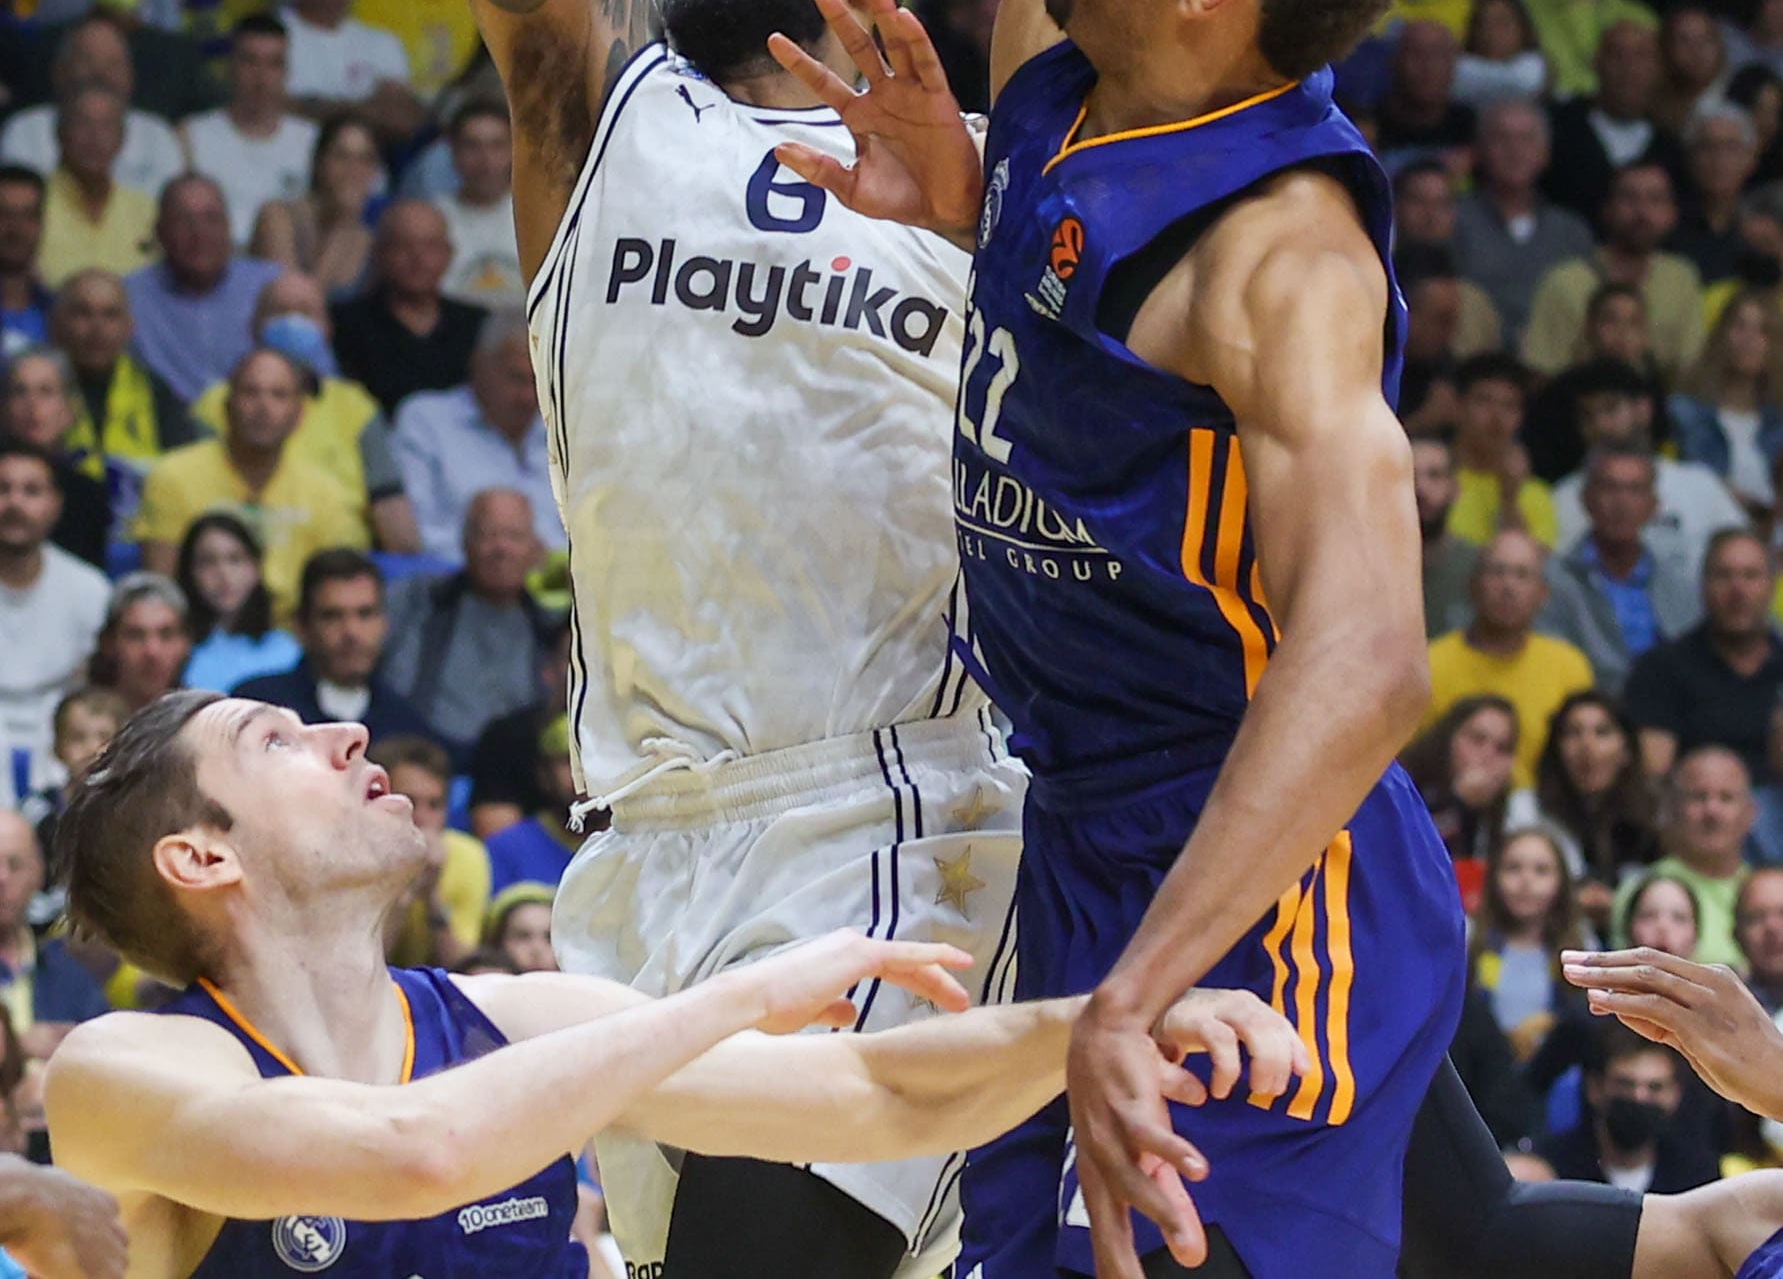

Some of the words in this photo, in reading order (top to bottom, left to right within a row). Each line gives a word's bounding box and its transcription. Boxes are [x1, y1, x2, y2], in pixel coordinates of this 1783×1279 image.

[746, 146, 828, 234] 6
[605, 237, 949, 359] Playtika
[958, 306, 1020, 465] 22
[953, 457, 1098, 547] LLADIUM
[1006, 547, 1122, 581] GROUP
